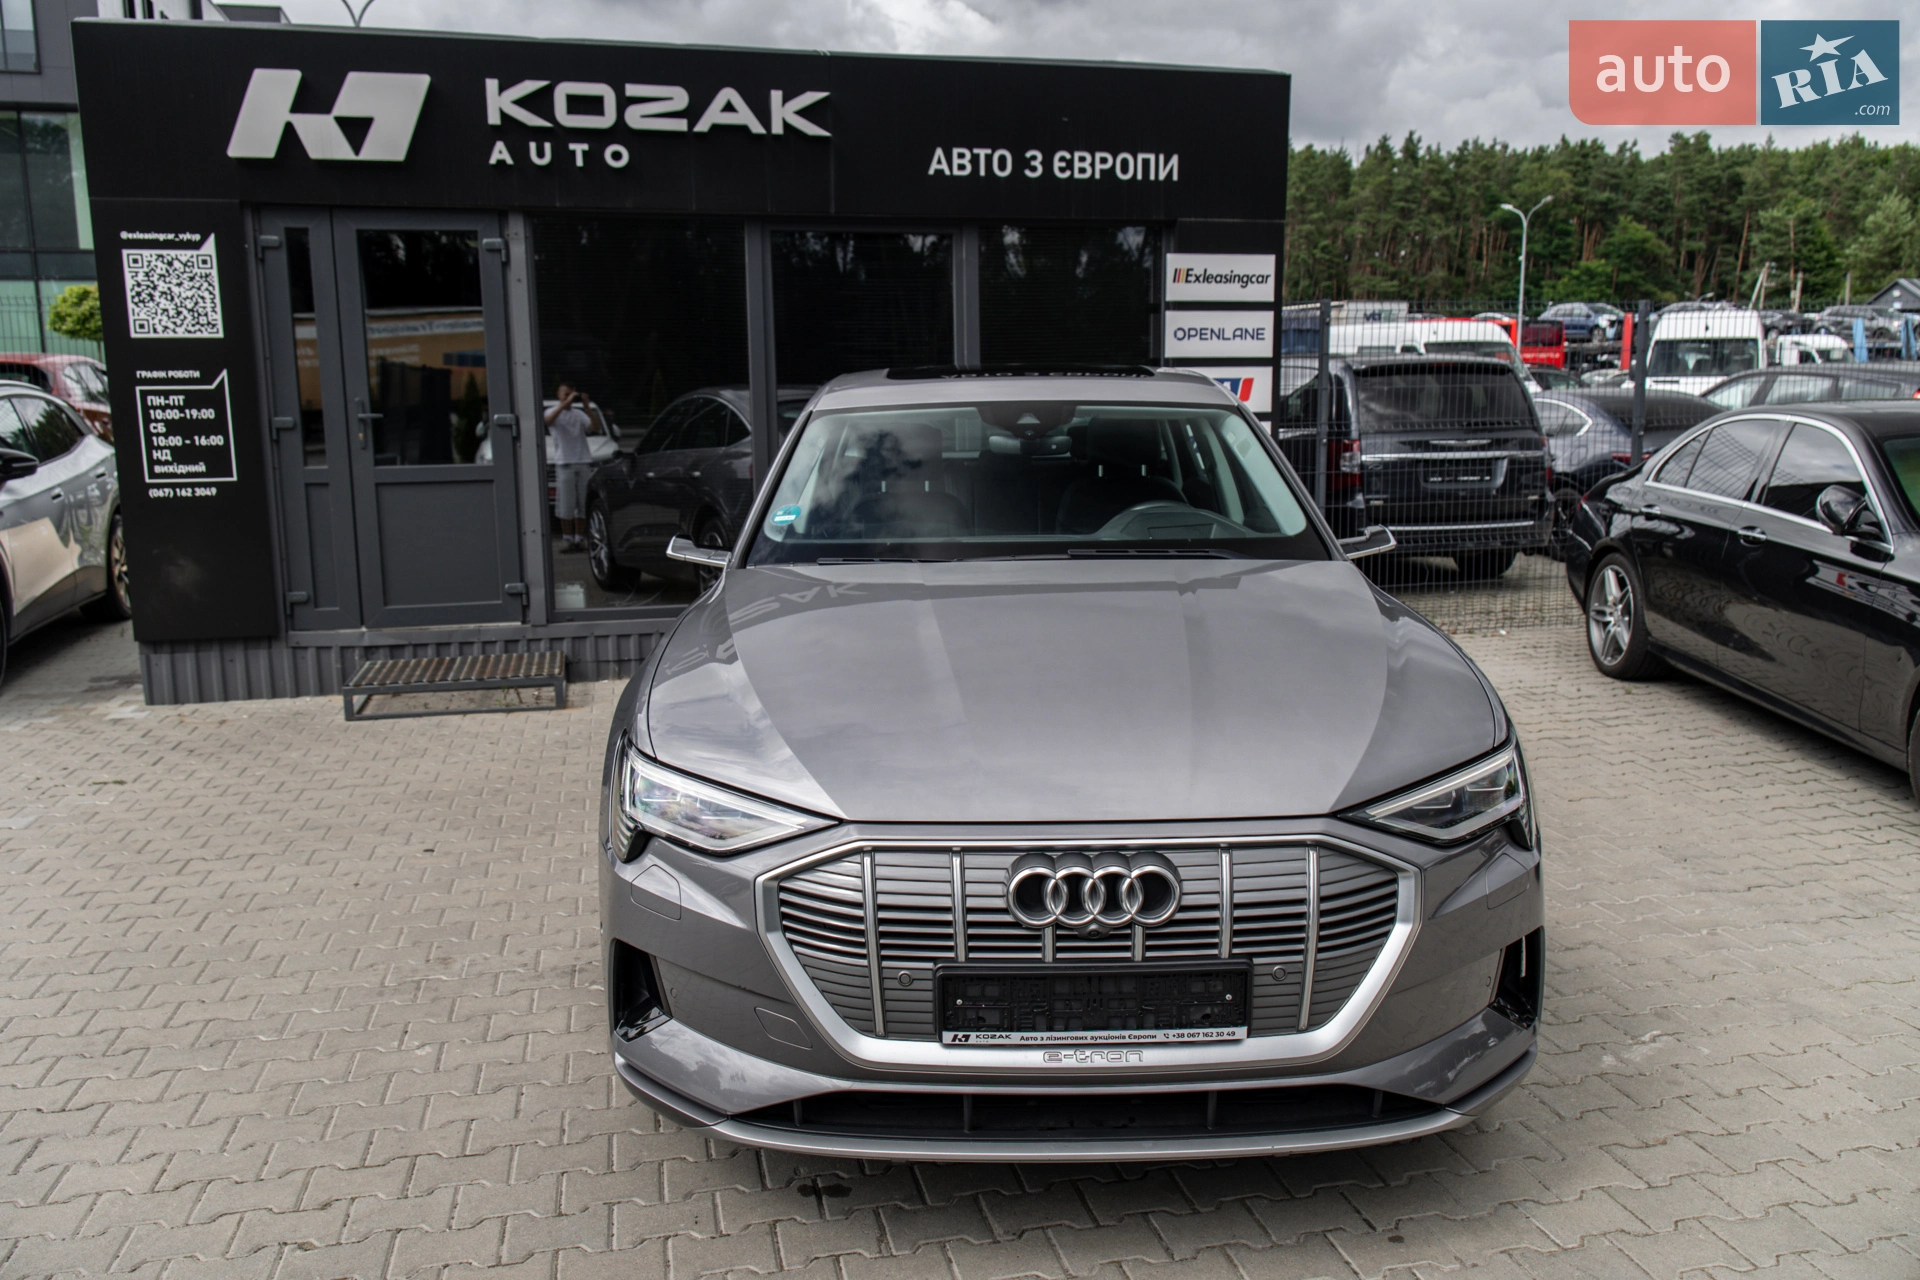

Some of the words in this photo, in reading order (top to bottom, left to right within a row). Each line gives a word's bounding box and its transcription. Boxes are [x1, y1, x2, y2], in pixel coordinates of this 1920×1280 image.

[485, 78, 832, 137] KOZAK
[488, 140, 630, 169] AUTO
[928, 147, 1012, 177] АВТО
[1023, 150, 1043, 178] З
[1053, 150, 1179, 182] ЄВРОПИ
[1185, 268, 1271, 289] Exleasingcar
[1174, 327, 1266, 341] OPENLANE
[168, 370, 200, 378] РОБОТИ
[147, 395, 185, 406] ПН-ПТ
[149, 408, 215, 420] 10:00-19:00
[149, 422, 166, 433] СБ
[152, 436, 182, 446] 10:00
[194, 435, 224, 446] 16:00
[152, 449, 172, 461] НД
[154, 462, 206, 474] вихідний
[149, 487, 174, 498] (067)
[176, 487, 193, 497] 162
[194, 486, 217, 497] 3049
[1128, 1033, 1157, 1042] Європи
[1043, 1048, 1144, 1064] e-tron
